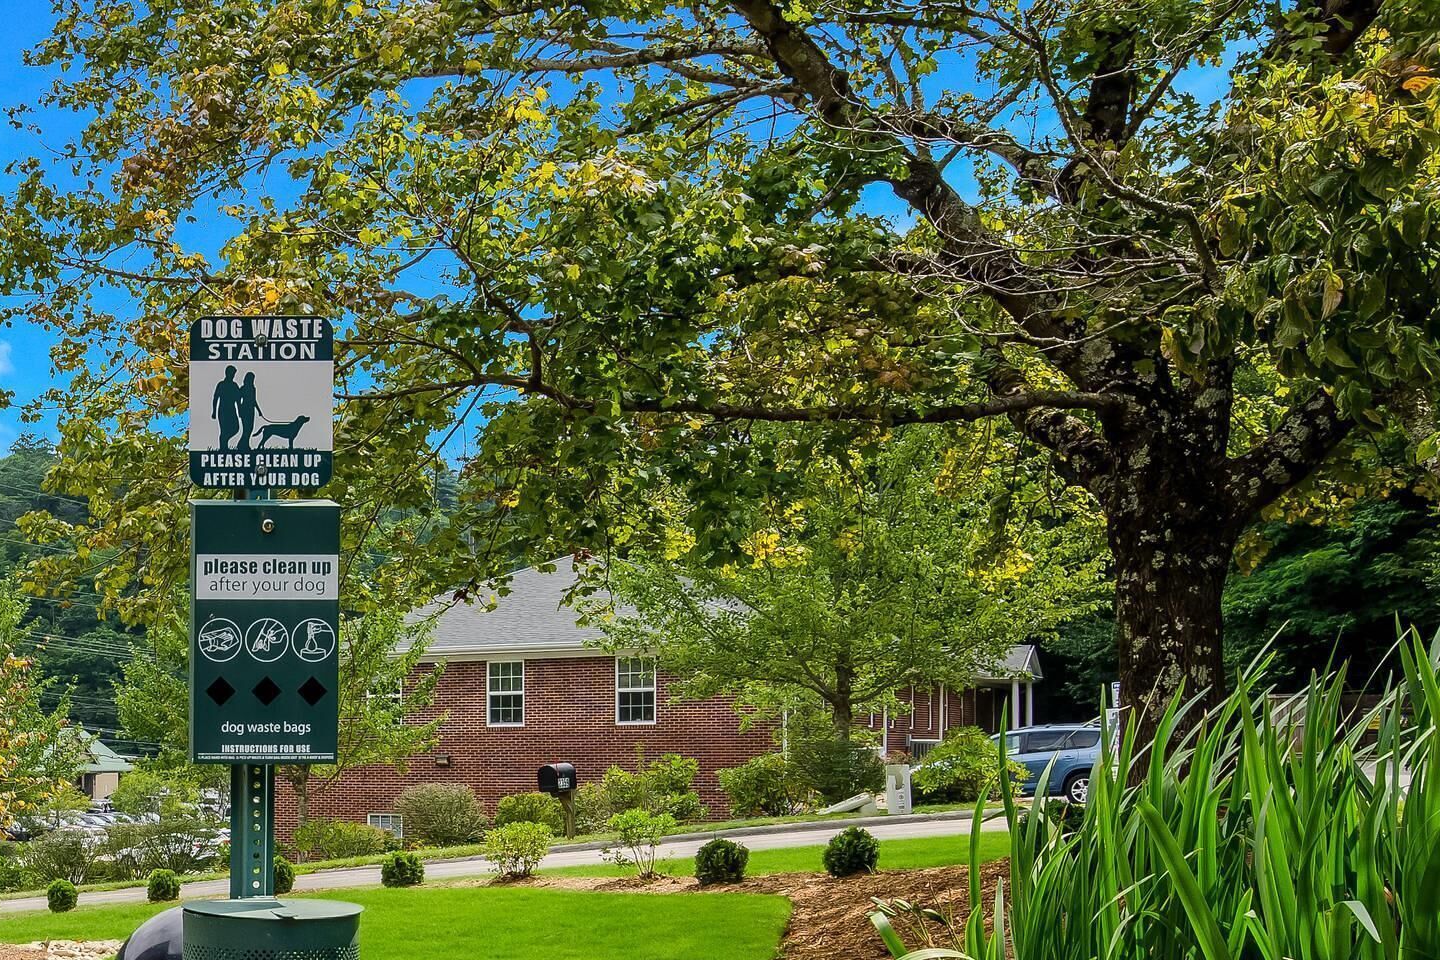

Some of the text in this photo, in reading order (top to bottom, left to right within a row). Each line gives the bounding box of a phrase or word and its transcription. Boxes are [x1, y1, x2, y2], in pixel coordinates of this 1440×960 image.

[200, 319, 323, 339] DOG WASTE
[208, 343, 316, 360] STATION
[200, 453, 322, 468] PLEASE CLEAN UP
[203, 472, 320, 486] AFTER YOUR DOG
[203, 558, 331, 576] please clean up
[209, 576, 326, 596] after your dog
[221, 720, 311, 736] dog waste bags
[221, 744, 311, 753] INSTRUCTIONS FOR USE
